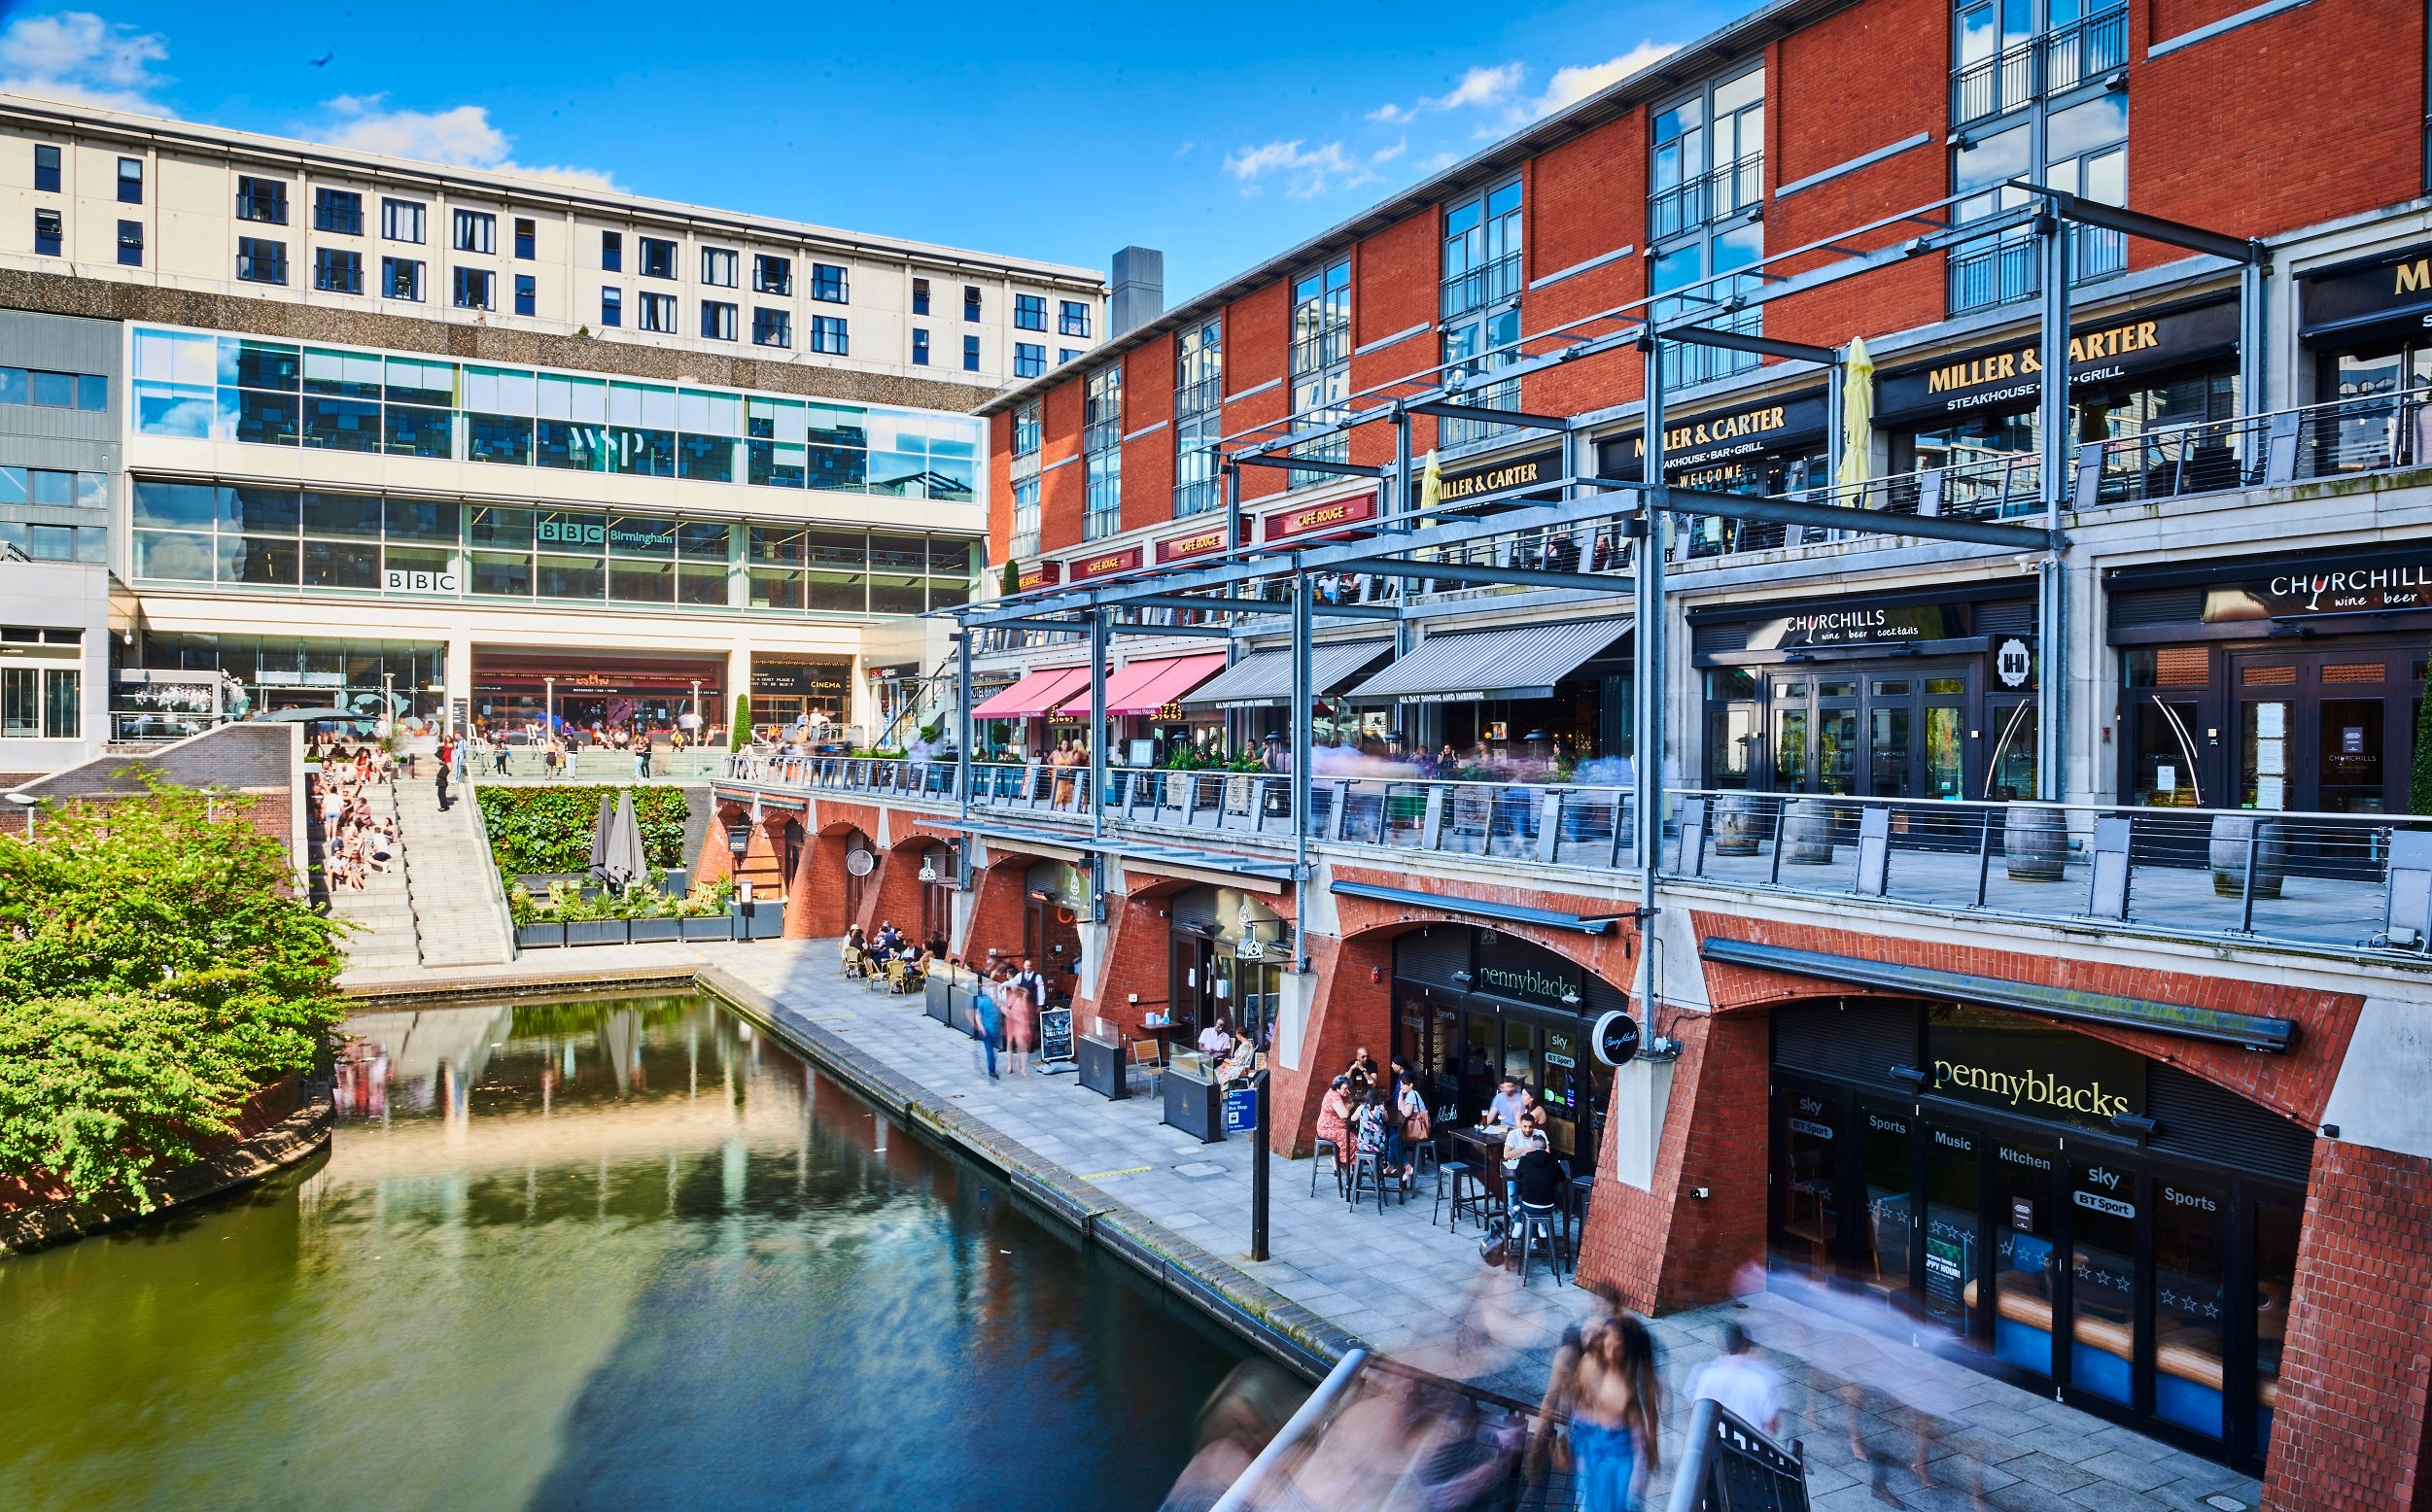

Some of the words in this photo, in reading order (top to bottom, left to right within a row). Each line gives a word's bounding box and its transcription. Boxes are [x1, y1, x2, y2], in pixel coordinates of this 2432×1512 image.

[1928, 353, 2016, 394] MILLER
[2020, 348, 2042, 374] &
[2068, 321, 2159, 363] ARTER
[1947, 383, 2035, 411] STEAKHOUSE
[2079, 365, 2125, 384] GRILL
[1634, 427, 1692, 459] MLER
[1695, 424, 1712, 445] &
[1712, 406, 1786, 440] CARTER
[571, 428, 643, 466] WSP
[1663, 452, 1707, 469] AKHOUSE
[1710, 448, 1730, 460] BAR
[1734, 442, 1764, 455] GRILL
[1441, 478, 1475, 499] ILLER
[1475, 475, 1487, 492] &
[1487, 463, 1538, 490] CARTER
[1680, 464, 1743, 488] WELCOME
[1297, 511, 1316, 527] CAFÉ
[1317, 506, 1343, 524] ROUGE
[542, 524, 602, 541] BBC
[610, 530, 673, 544] Birmingham
[1196, 536, 1219, 549] ROUGE
[1101, 558, 1119, 570] ROUGE
[388, 571, 456, 591] BBC
[2271, 566, 2432, 601] CHURCHILL
[2335, 597, 2368, 607] wine
[2383, 592, 2417, 604] beer
[1787, 609, 1886, 638] CHURCHILLS
[1822, 632, 1840, 640] wine
[1848, 630, 1868, 639] beer
[1877, 626, 1919, 636] cocktails
[972, 686, 984, 698] OTEL
[1442, 693, 1456, 702] AND
[1479, 967, 1577, 997] pennyblacks
[1436, 1008, 1455, 1020] Sports
[1551, 1034, 1568, 1049] sky
[1557, 1056, 1573, 1065] Sport
[1933, 1059, 2129, 1117] pennyblacks
[1799, 1096, 1823, 1117] sky
[1793, 1120, 1806, 1130] BT
[1807, 1123, 1828, 1136] Sport
[1869, 1115, 1906, 1134] Sports
[1935, 1131, 1971, 1151] Music
[1999, 1147, 2051, 1170] Kitchen
[2088, 1167, 2120, 1189] sky
[2079, 1194, 2097, 1206] BT
[2098, 1195, 2129, 1216] Sport
[2165, 1186, 2216, 1212] Sports
[1940, 1264, 1961, 1278] HOUR!
